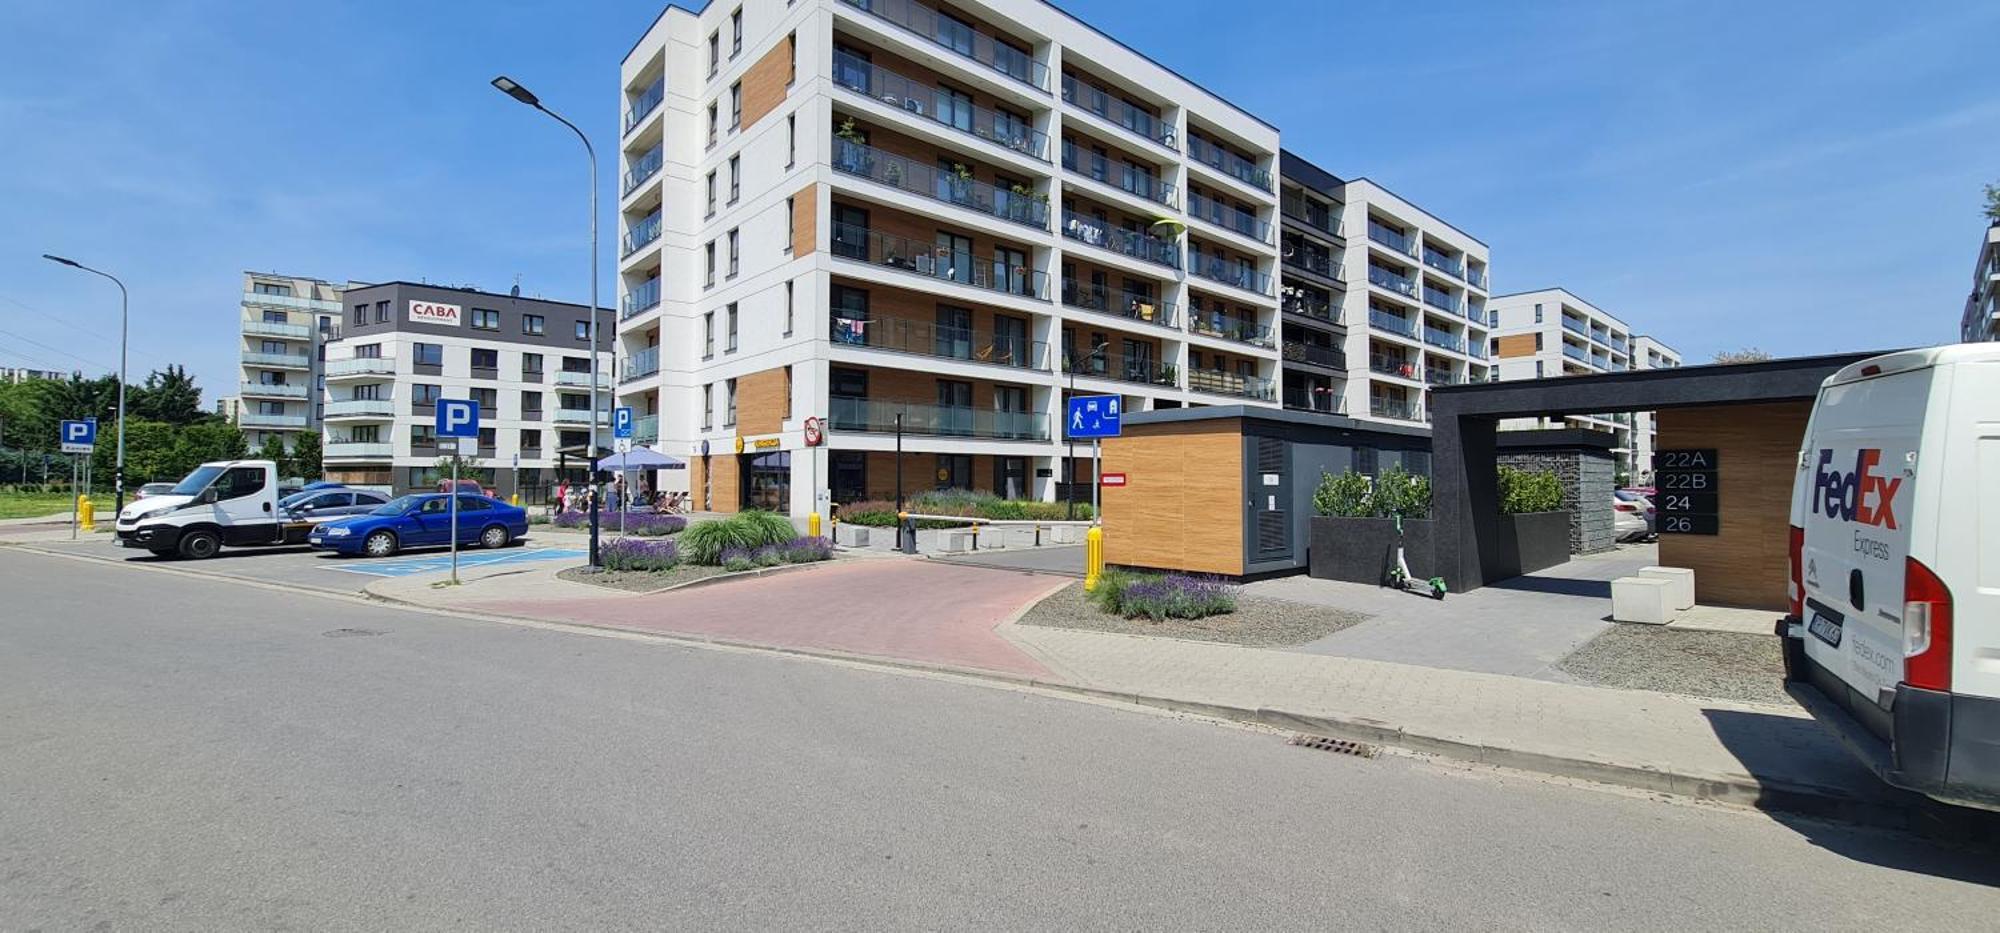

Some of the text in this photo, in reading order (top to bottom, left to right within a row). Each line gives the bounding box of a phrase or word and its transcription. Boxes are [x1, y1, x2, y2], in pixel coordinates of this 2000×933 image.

[413, 303, 456, 318] CABA
[446, 403, 470, 432] P
[618, 410, 629, 430] P
[69, 423, 88, 441] P
[1665, 451, 1707, 467] 22A
[1665, 473, 1707, 489] 22B
[1813, 448, 1902, 530] FedEx
[1666, 495, 1691, 510] 24
[1666, 516, 1692, 532] 26
[1854, 529, 1889, 561] Express
